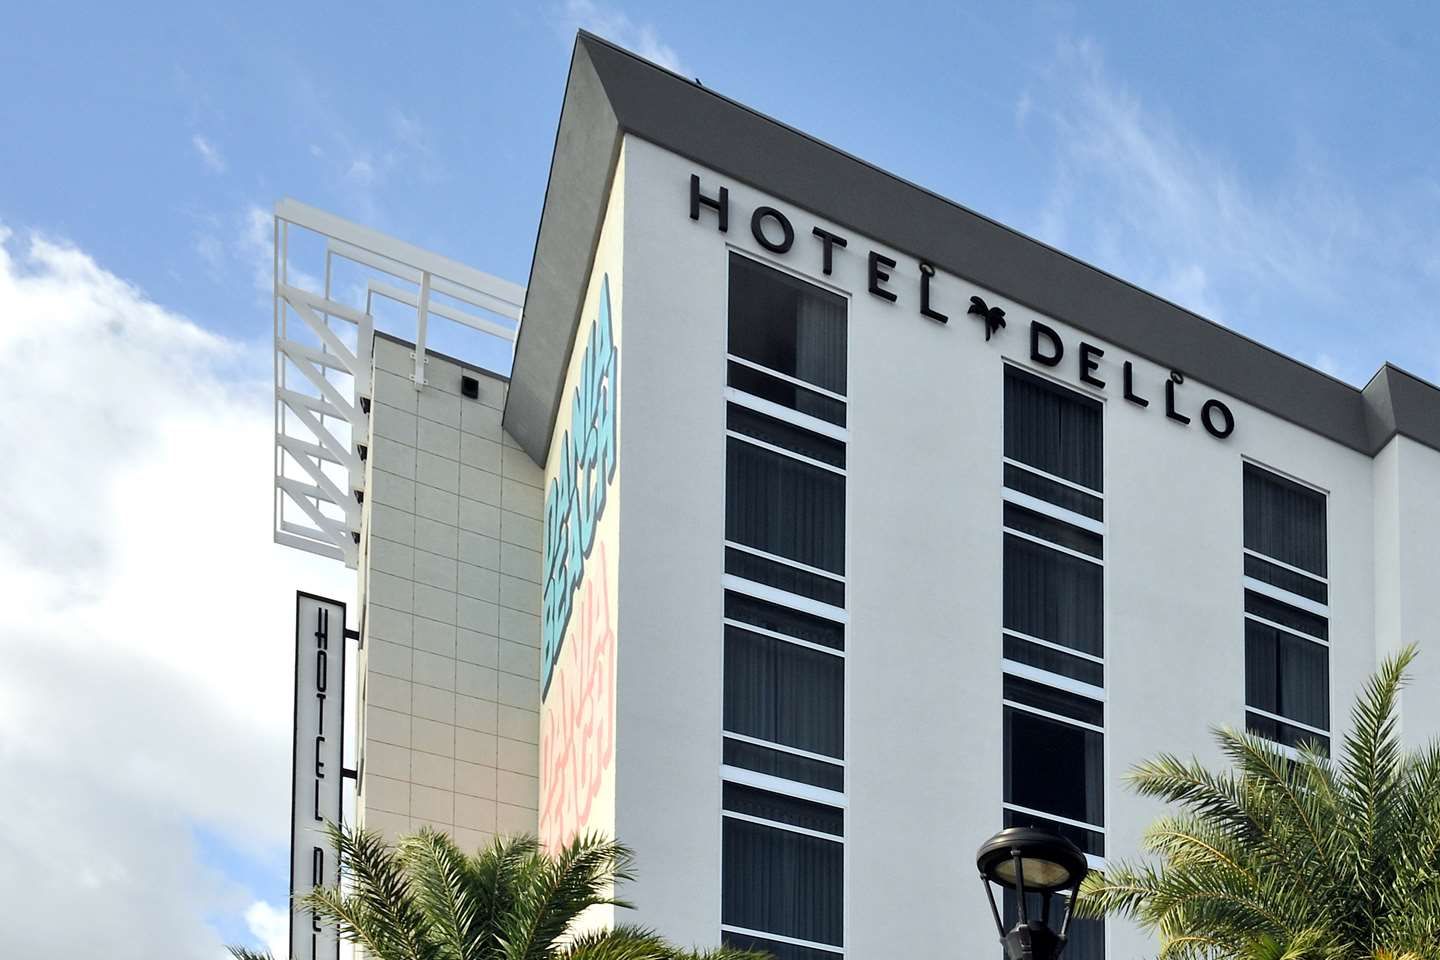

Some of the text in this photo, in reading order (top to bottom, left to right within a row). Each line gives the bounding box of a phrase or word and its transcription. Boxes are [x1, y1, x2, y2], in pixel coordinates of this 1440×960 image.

[543, 271, 614, 596] DANIA
[689, 172, 1236, 440] HOTEL DELLO
[541, 345, 618, 703] BEACH
[314, 607, 329, 823] HOTEL
